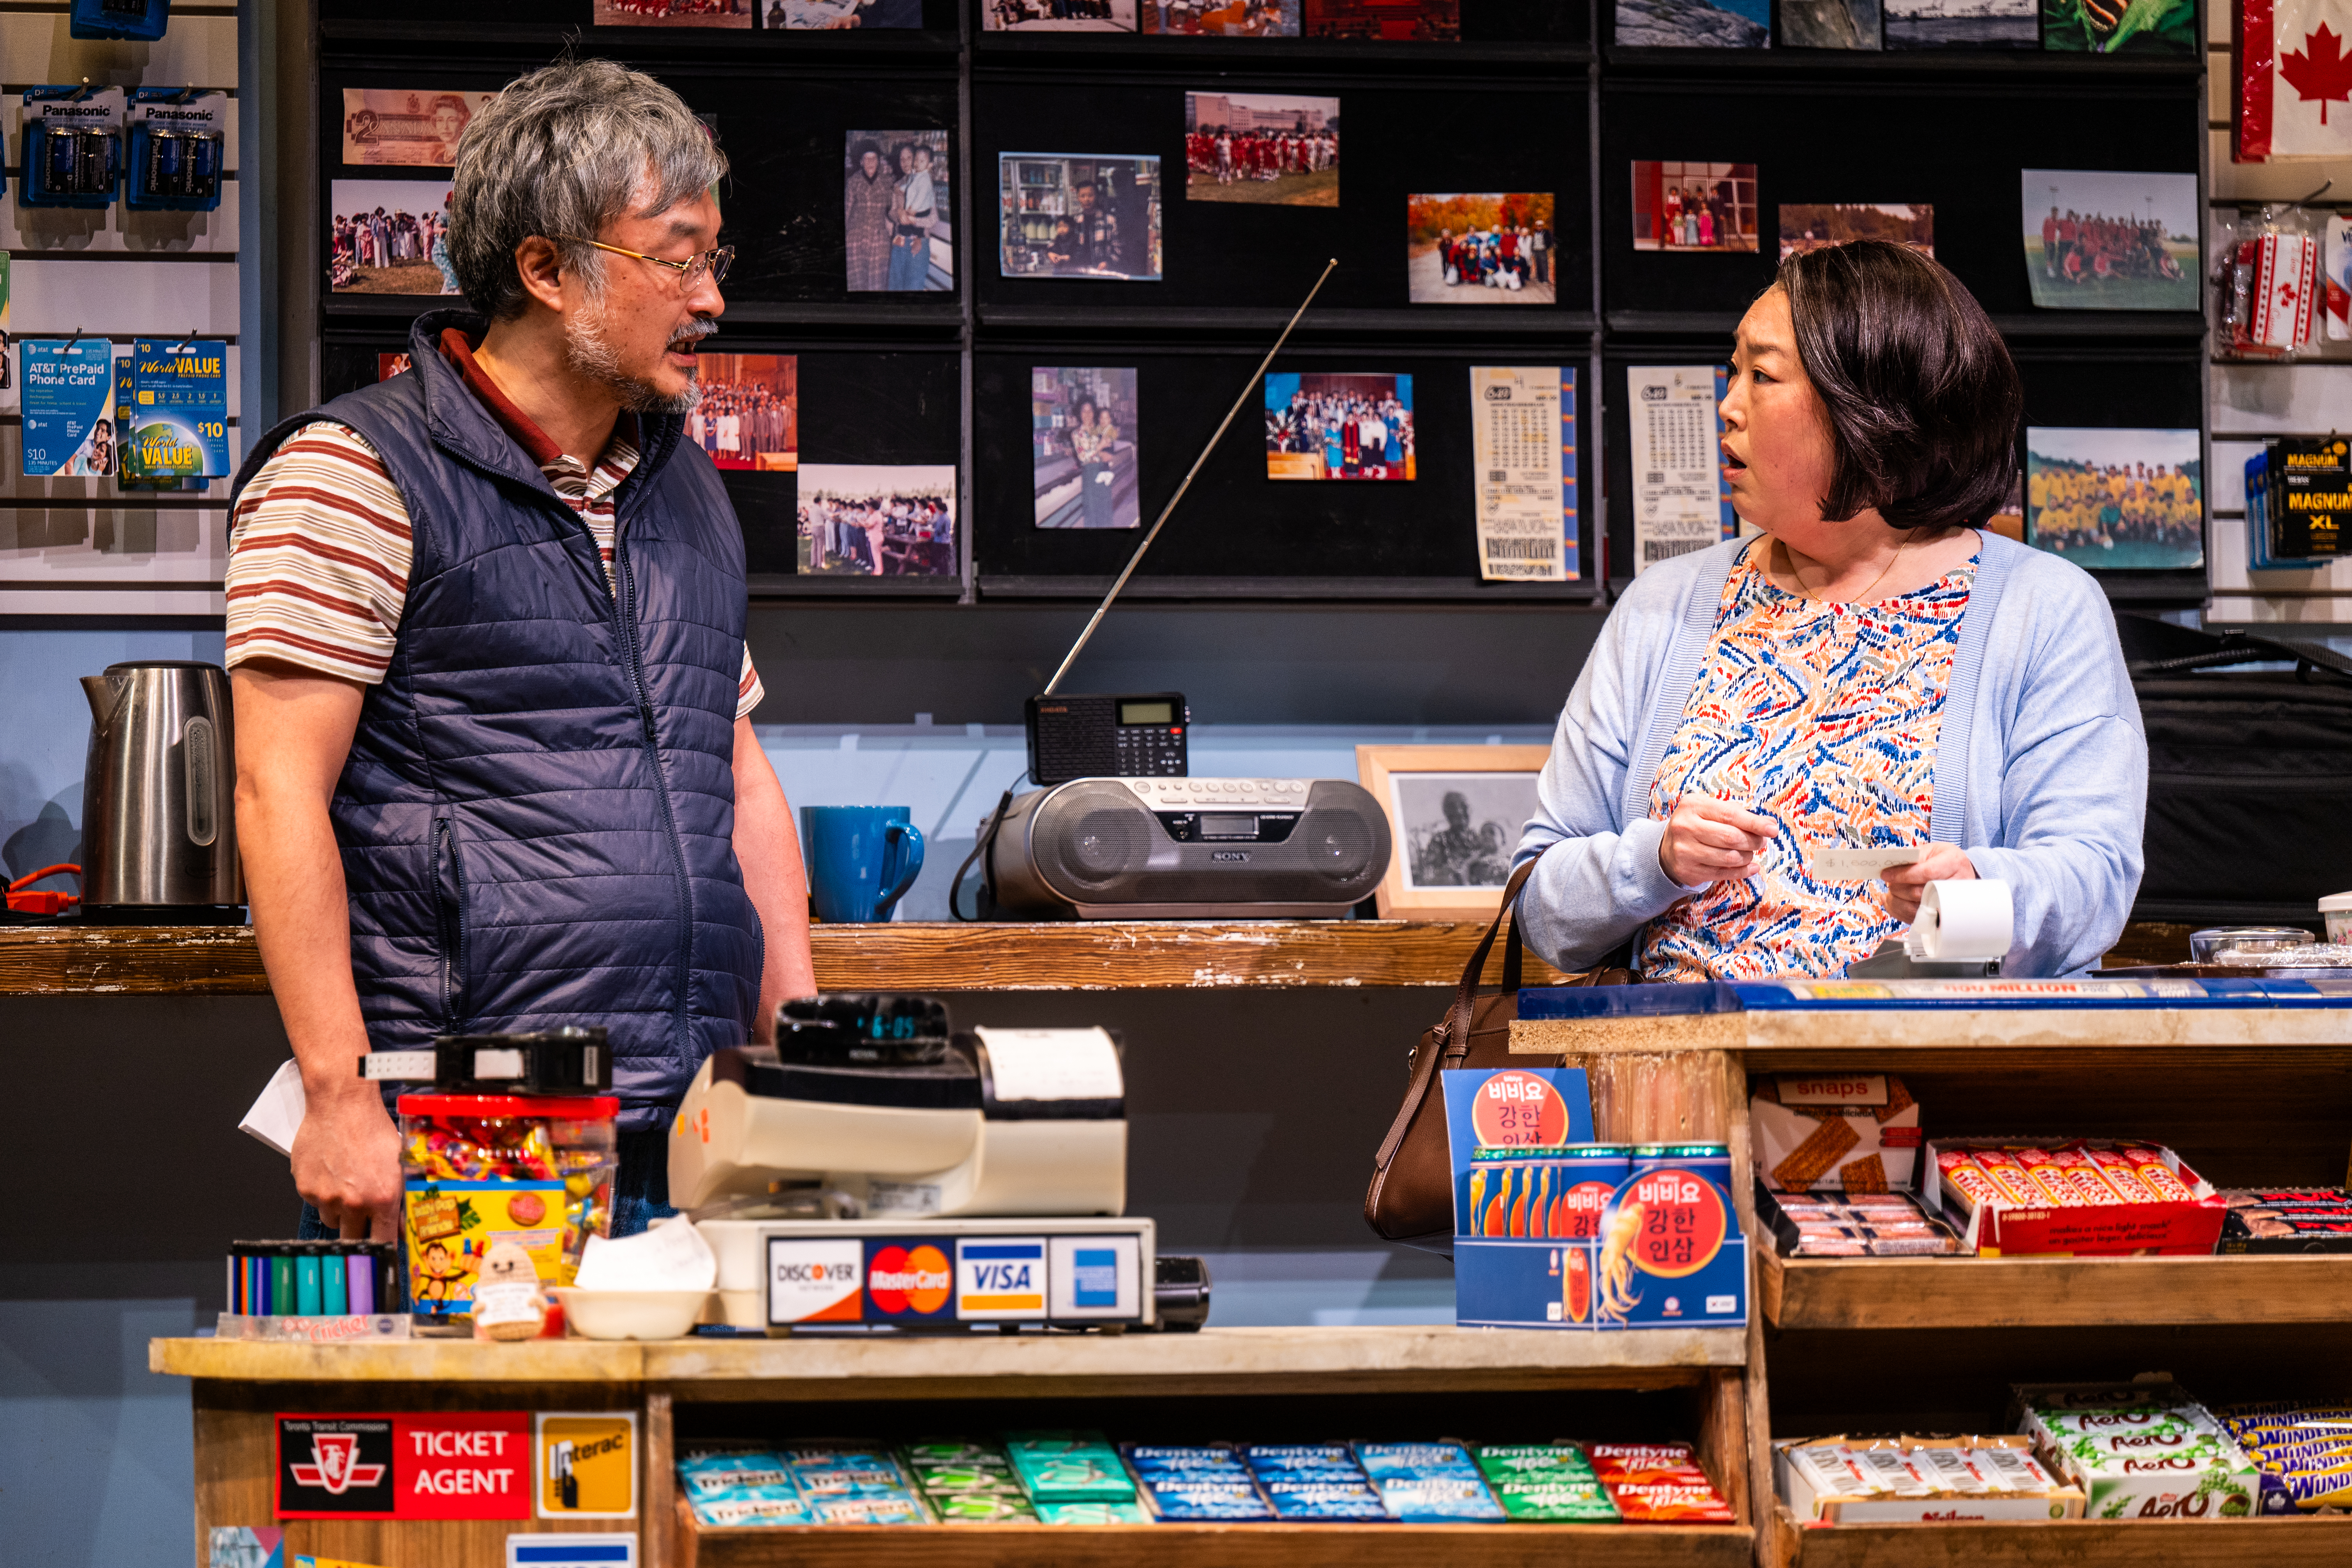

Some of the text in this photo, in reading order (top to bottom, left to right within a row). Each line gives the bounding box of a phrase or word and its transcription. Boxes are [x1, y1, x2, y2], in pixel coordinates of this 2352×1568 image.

[43, 105, 110, 116] Panasonic
[146, 108, 213, 120] Panasonic
[45, 136, 53, 189] Panasonic
[150, 138, 161, 192] Panasonic
[186, 139, 196, 193] Panasonic
[138, 344, 151, 353] $10
[29, 363, 104, 375] AT&T PrePaid
[139, 357, 221, 374] World VALUE
[30, 374, 95, 385] Phone Card
[198, 422, 223, 438] $10
[143, 436, 178, 448] World
[28, 448, 46, 460] $10
[142, 448, 192, 465] VALUE
[2287, 453, 2338, 466] MAGNUM
[2288, 492, 2352, 510] MAGNUM
[2309, 514, 2340, 530] XL
[1213, 852, 1249, 862] SONY
[1989, 984, 2077, 992] MILLION
[1487, 1082, 1544, 1102] 비비요
[1797, 1081, 1868, 1098] snaps
[1498, 1104, 1540, 1129] 강한
[1638, 1181, 1701, 1206] 비비요
[1647, 1208, 1695, 1235] 강한
[2049, 1226, 2082, 1235] makes
[2116, 1222, 2137, 1233] light
[1648, 1237, 1694, 1263] 인삼
[777, 1263, 854, 1281] DISCOVER
[870, 1270, 948, 1290] MasterCard
[974, 1265, 1030, 1289] VISA
[284, 1421, 310, 1431] Toronto
[312, 1421, 338, 1430] Transit
[409, 1431, 508, 1457] TICKET
[1250, 1447, 1345, 1457] Dentyne
[1481, 1446, 1574, 1458] Dentyne
[1135, 1447, 1230, 1458] Dentyne
[1594, 1446, 1688, 1459] Dentyne
[414, 1468, 514, 1494] AGENT
[702, 1472, 782, 1487] Trident
[813, 1471, 891, 1487] Trident
[1156, 1481, 1252, 1493] Dentyne
[1271, 1482, 1366, 1493] Dentyne
[1503, 1483, 1597, 1494] Dentyne
[1618, 1484, 1712, 1496] Dentyne
[718, 1502, 798, 1519] Trident
[832, 1502, 909, 1519] Trident
